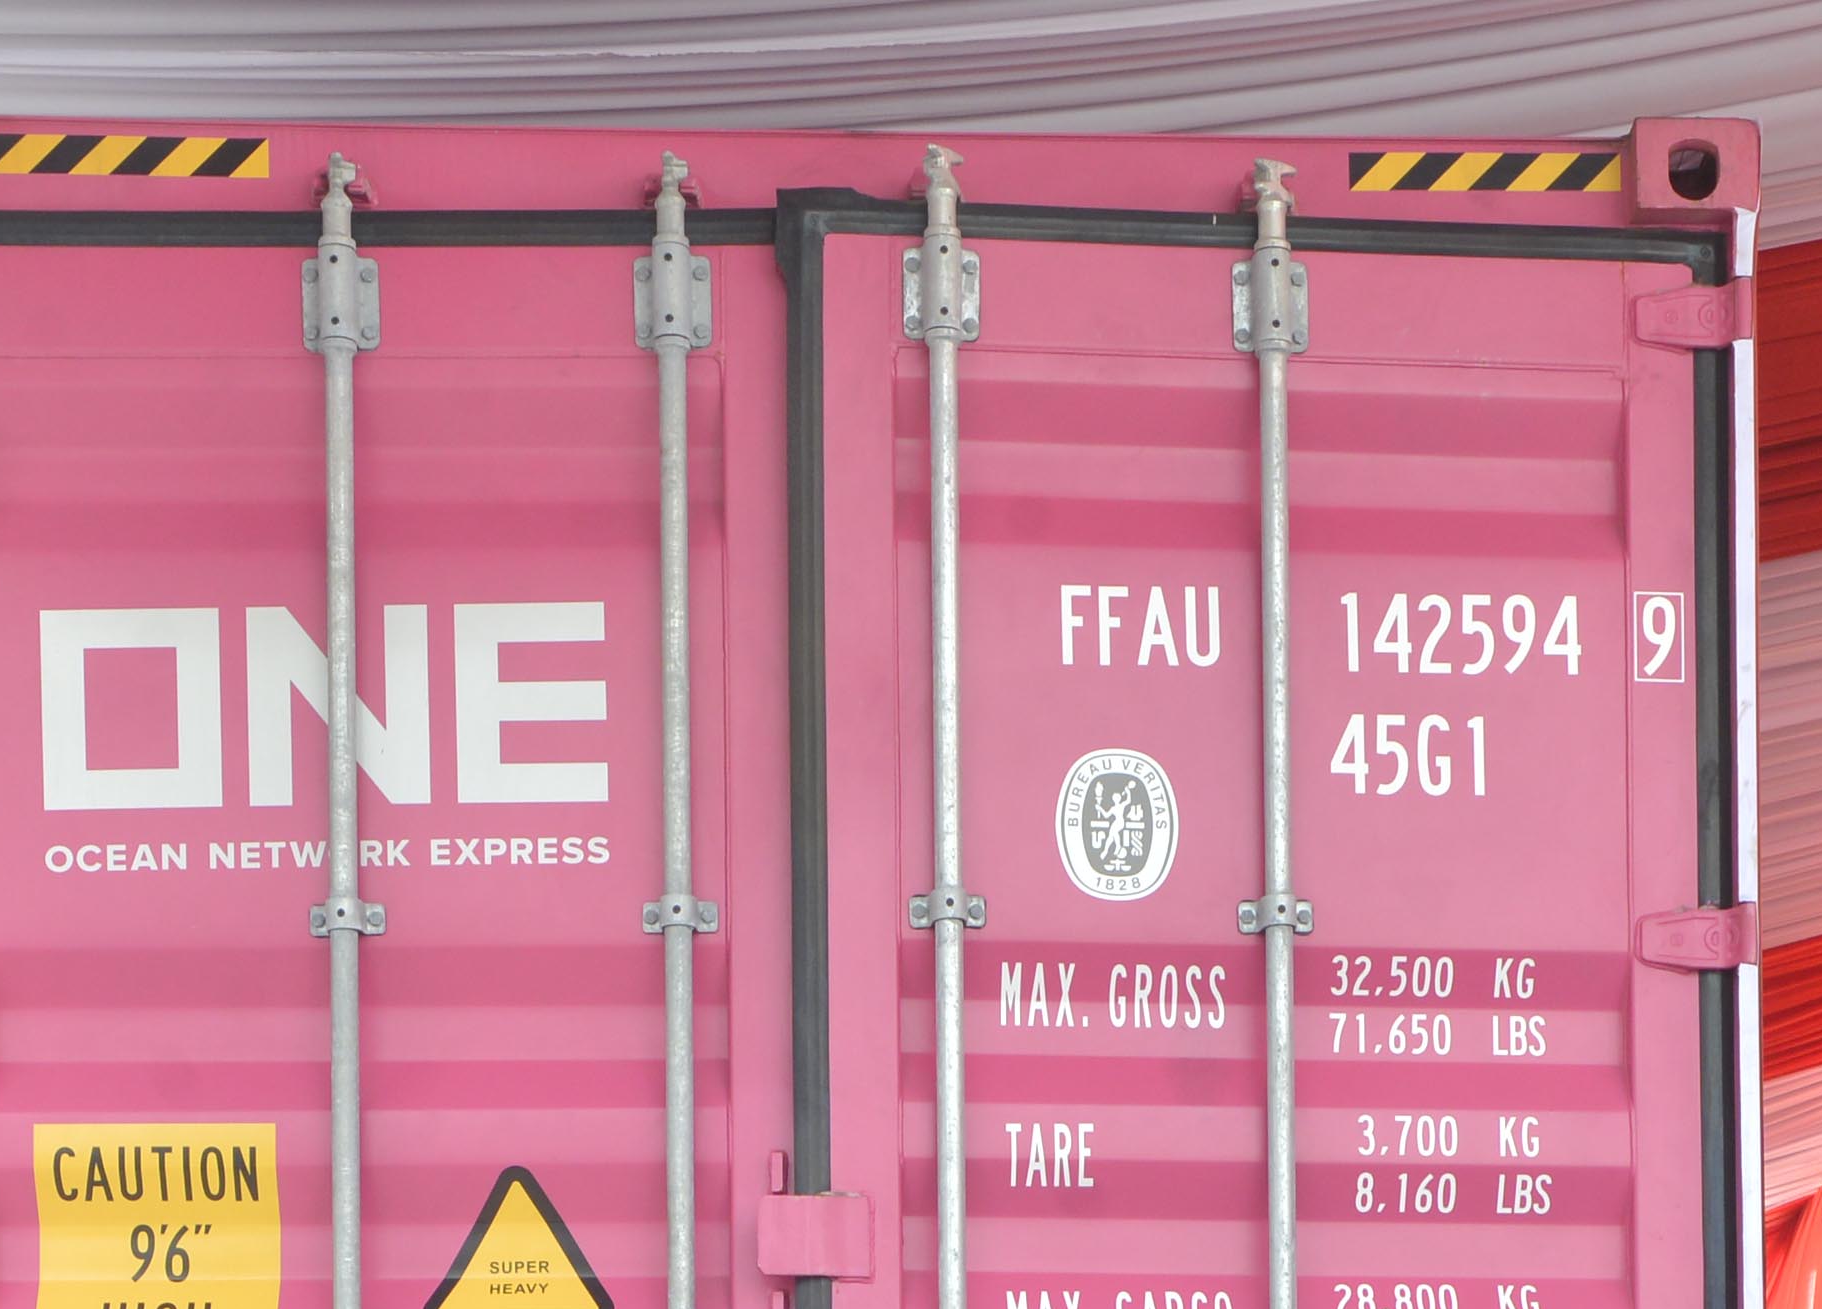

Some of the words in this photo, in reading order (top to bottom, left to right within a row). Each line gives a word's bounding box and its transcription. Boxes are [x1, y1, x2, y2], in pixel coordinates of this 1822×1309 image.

[1060, 584, 1221, 668] FFAU
[1340, 591, 1583, 676] 142594
[1642, 595, 1676, 677] 9
[39, 601, 610, 811] ONE
[1330, 713, 1487, 797] 45G1
[1067, 758, 1113, 827] BUREAU
[1121, 758, 1168, 830] VERITAS
[44, 842, 188, 873] OCEAN
[209, 840, 411, 870] NETWRK
[430, 835, 611, 867] EXPRESS
[1095, 877, 1141, 892] 1828
[999, 961, 1090, 1029] MAX.
[1108, 963, 1226, 1030] GROSS
[1493, 957, 1536, 999] KG
[1491, 1014, 1547, 1057] LBS
[1004, 1122, 1096, 1188] TARE
[1498, 1115, 1540, 1159] KG
[53, 1147, 259, 1201] CAUTION
[1496, 1173, 1553, 1215] LBS
[489, 1260, 550, 1275] SUPER
[489, 1282, 550, 1296] HEAVY
